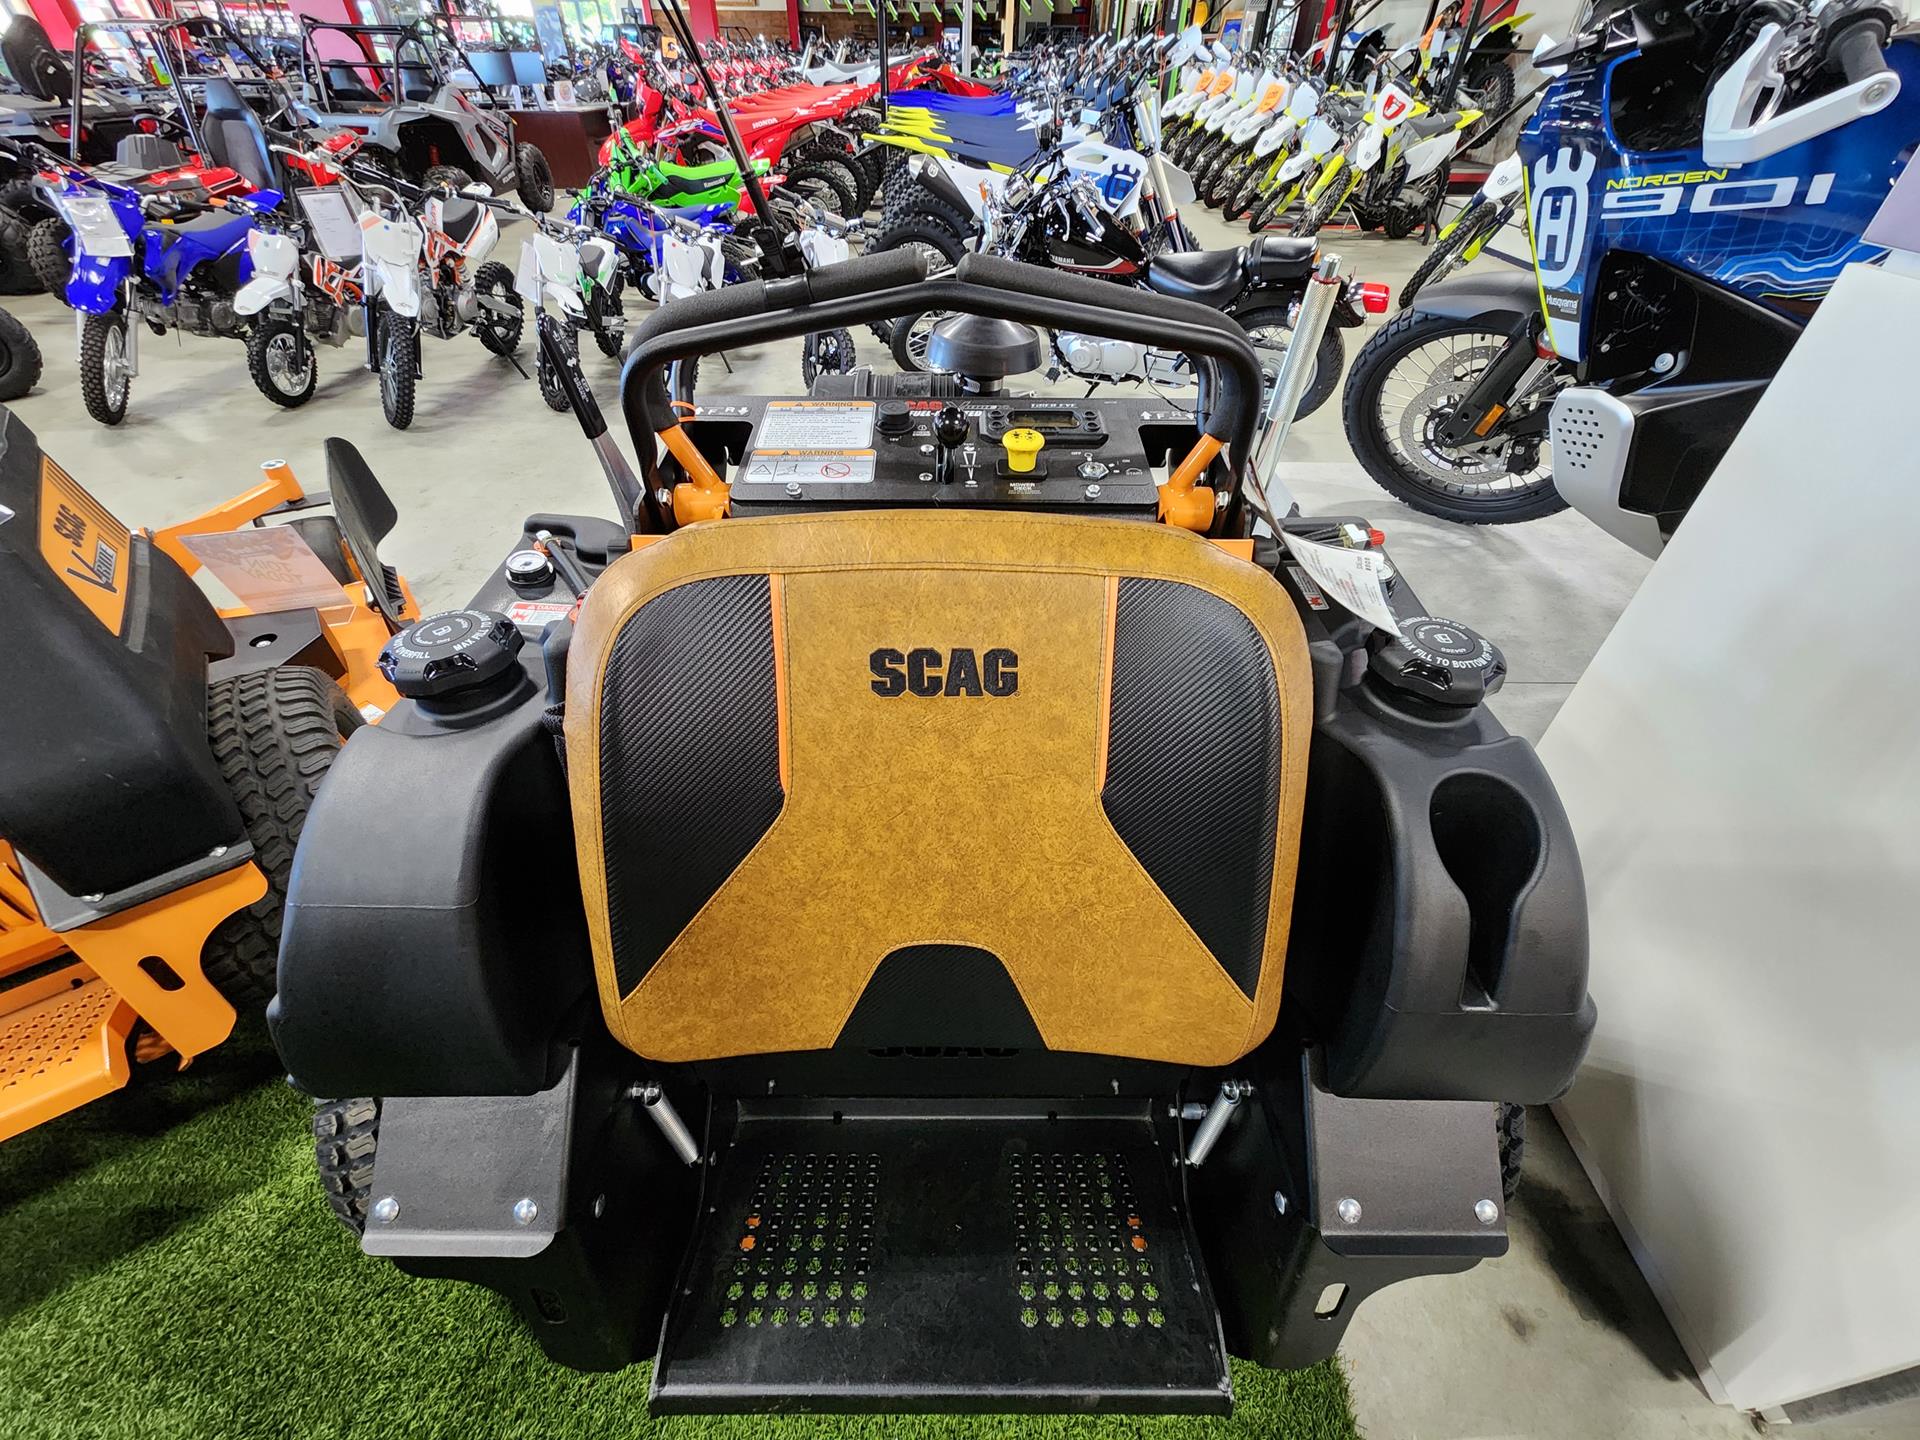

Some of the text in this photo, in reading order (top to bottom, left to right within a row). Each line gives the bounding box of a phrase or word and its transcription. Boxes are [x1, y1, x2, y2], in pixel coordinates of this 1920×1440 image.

[752, 117, 778, 129] HONDA
[1606, 168, 1728, 190] NORDEN
[1600, 173, 1837, 220] 901
[1050, 254, 1075, 265] YAMAHA
[1546, 294, 1578, 309] Husqvarna
[53, 503, 87, 548] SCAG
[453, 640, 474, 651] MAX
[475, 628, 490, 641] FILL
[395, 648, 431, 659] OVERFILL
[1413, 648, 1433, 662] FILL
[1436, 656, 1450, 666] TO
[869, 647, 1019, 698] SCAG
